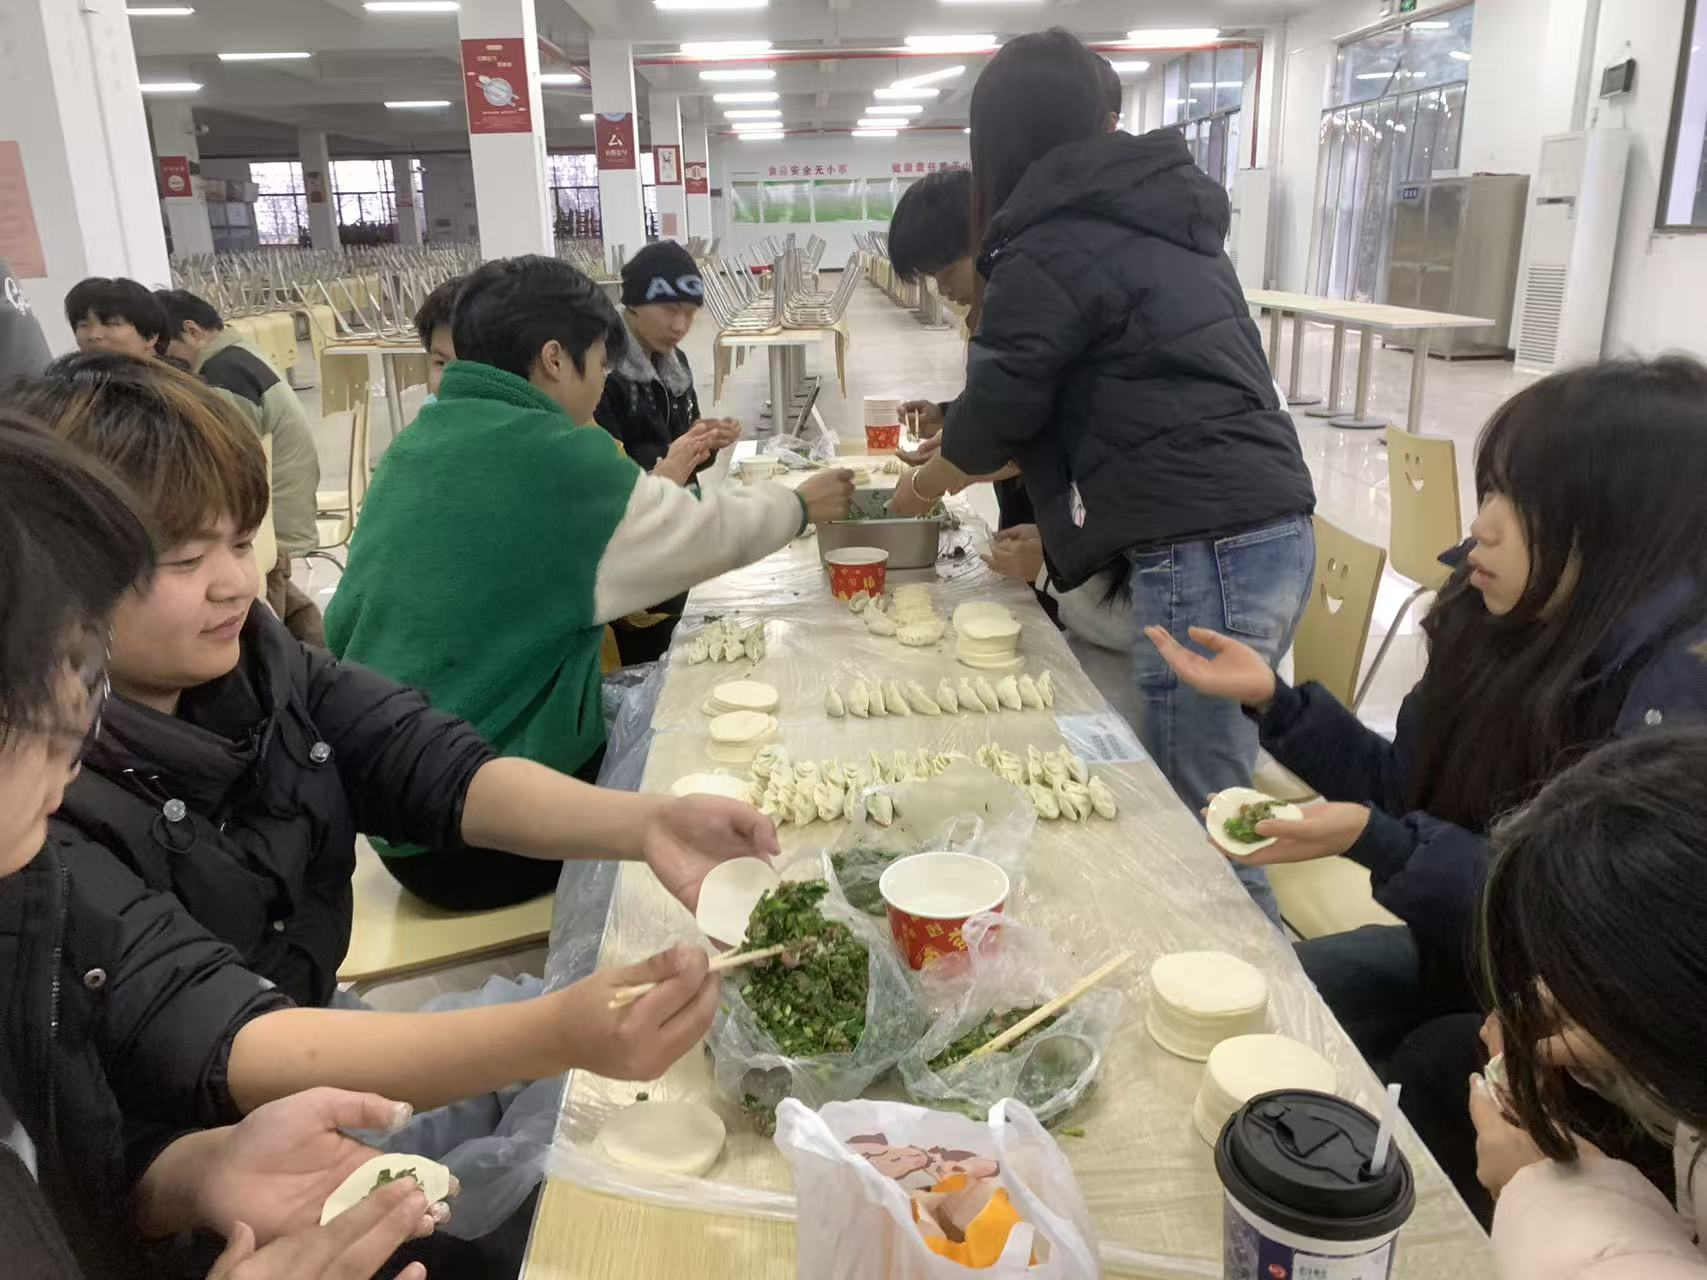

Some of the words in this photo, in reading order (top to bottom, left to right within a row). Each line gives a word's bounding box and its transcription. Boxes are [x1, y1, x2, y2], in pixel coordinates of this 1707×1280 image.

[768, 163, 848, 176] 食品安全无小事
